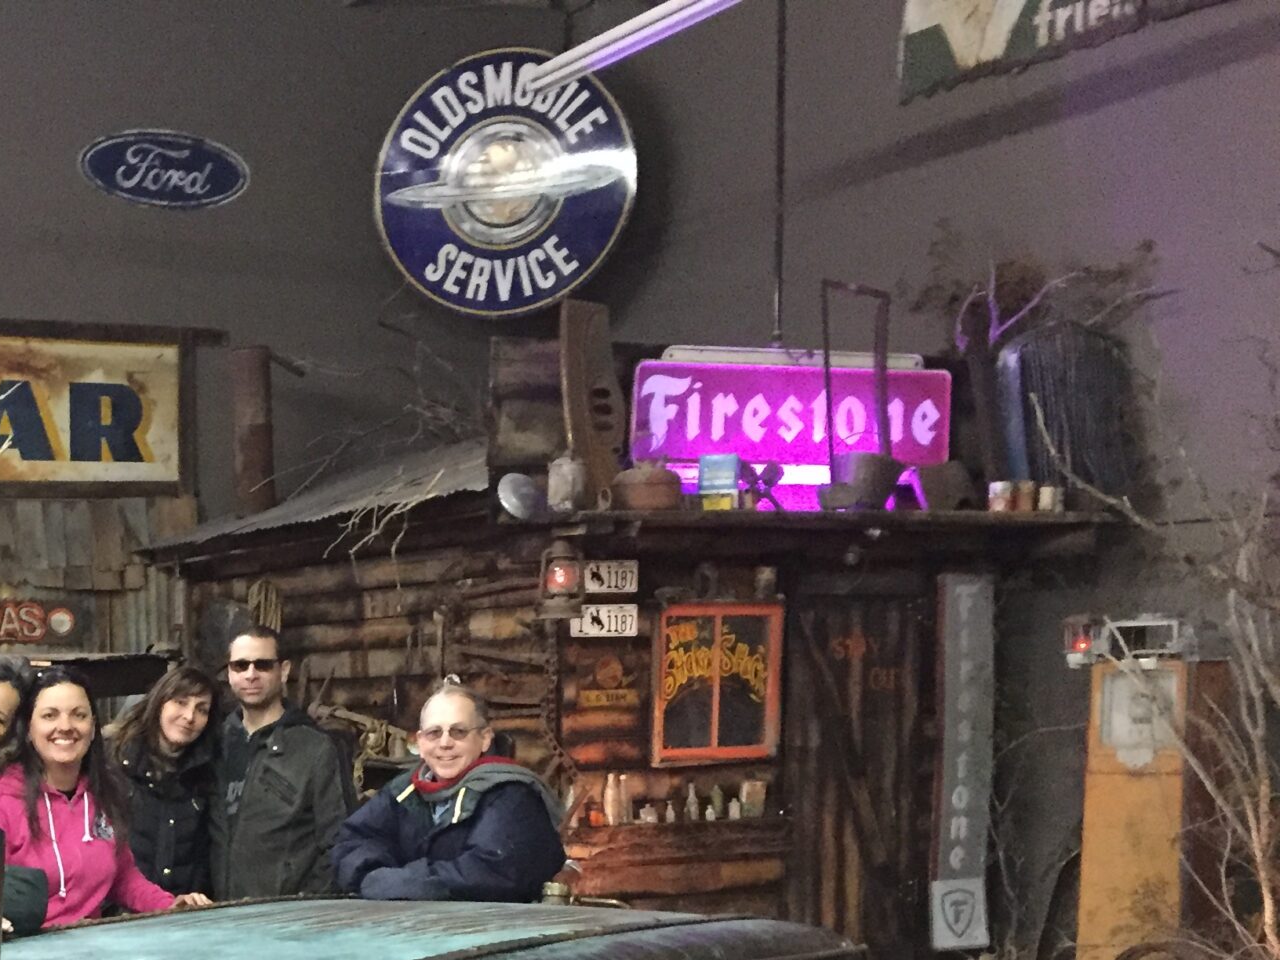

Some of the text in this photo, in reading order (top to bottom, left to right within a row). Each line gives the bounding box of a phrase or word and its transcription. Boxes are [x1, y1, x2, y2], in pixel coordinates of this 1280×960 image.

[400, 62, 609, 159] OLDSMOBILE
[115, 143, 214, 194] Ford
[424, 235, 580, 301] SERVICE
[641, 374, 941, 452] Firestone
